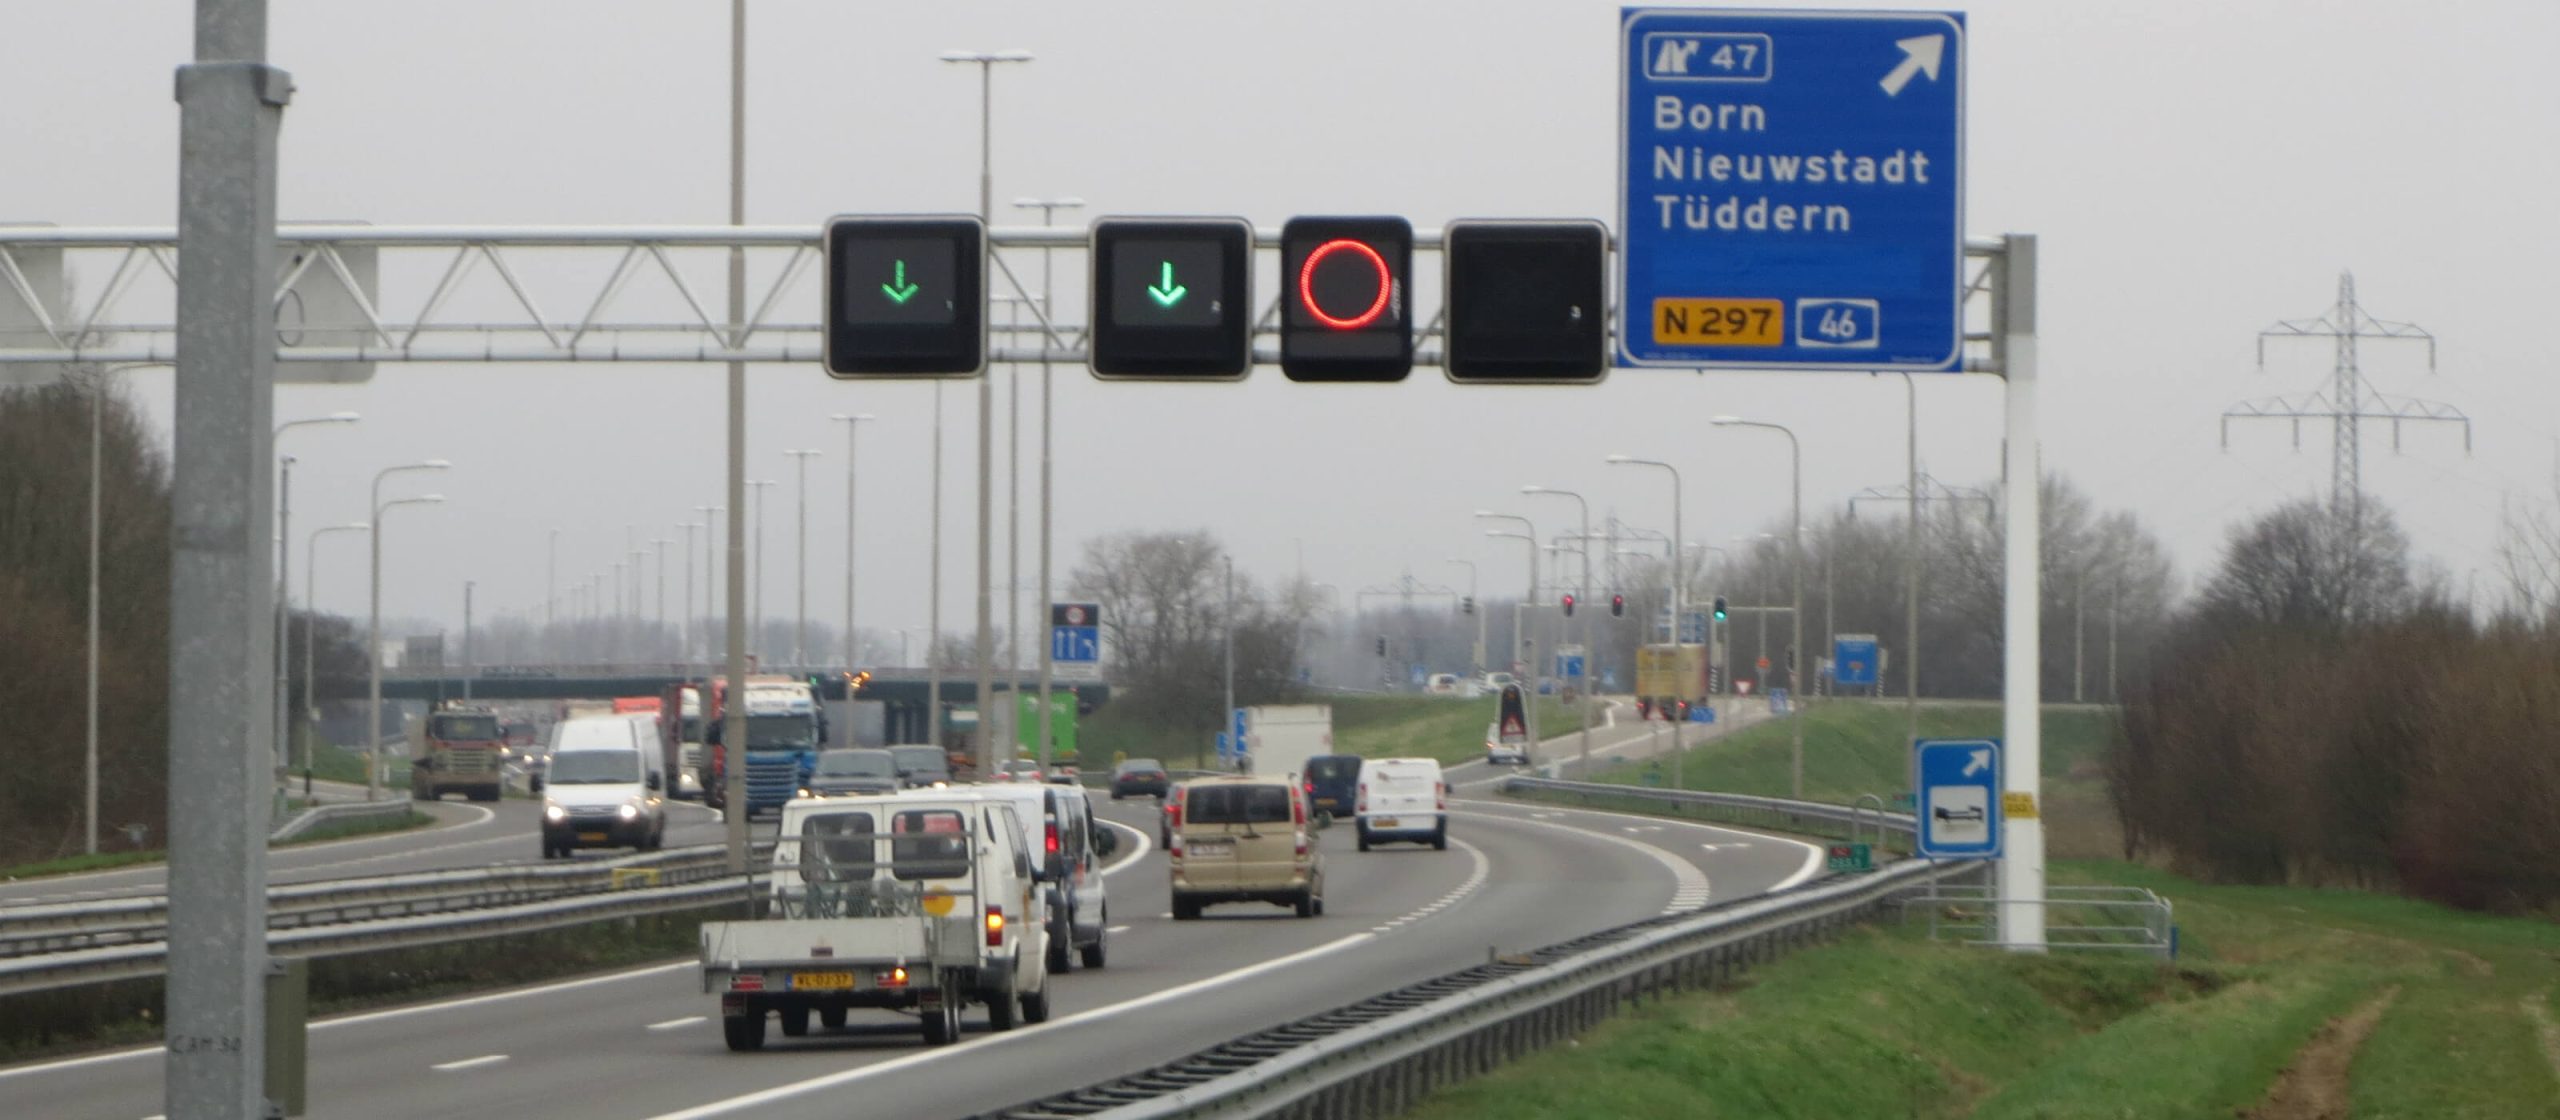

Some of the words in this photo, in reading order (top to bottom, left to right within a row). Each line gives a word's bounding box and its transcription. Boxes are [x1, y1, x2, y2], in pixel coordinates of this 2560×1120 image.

[1711, 45, 1758, 69] 47
[1655, 96, 1765, 130] Born
[1654, 147, 1929, 183] Nieuwstadt
[1654, 196, 1850, 231] Tüddern
[1663, 307, 1688, 334] N
[1700, 307, 1774, 336] 297
[1819, 309, 1856, 338] 46
